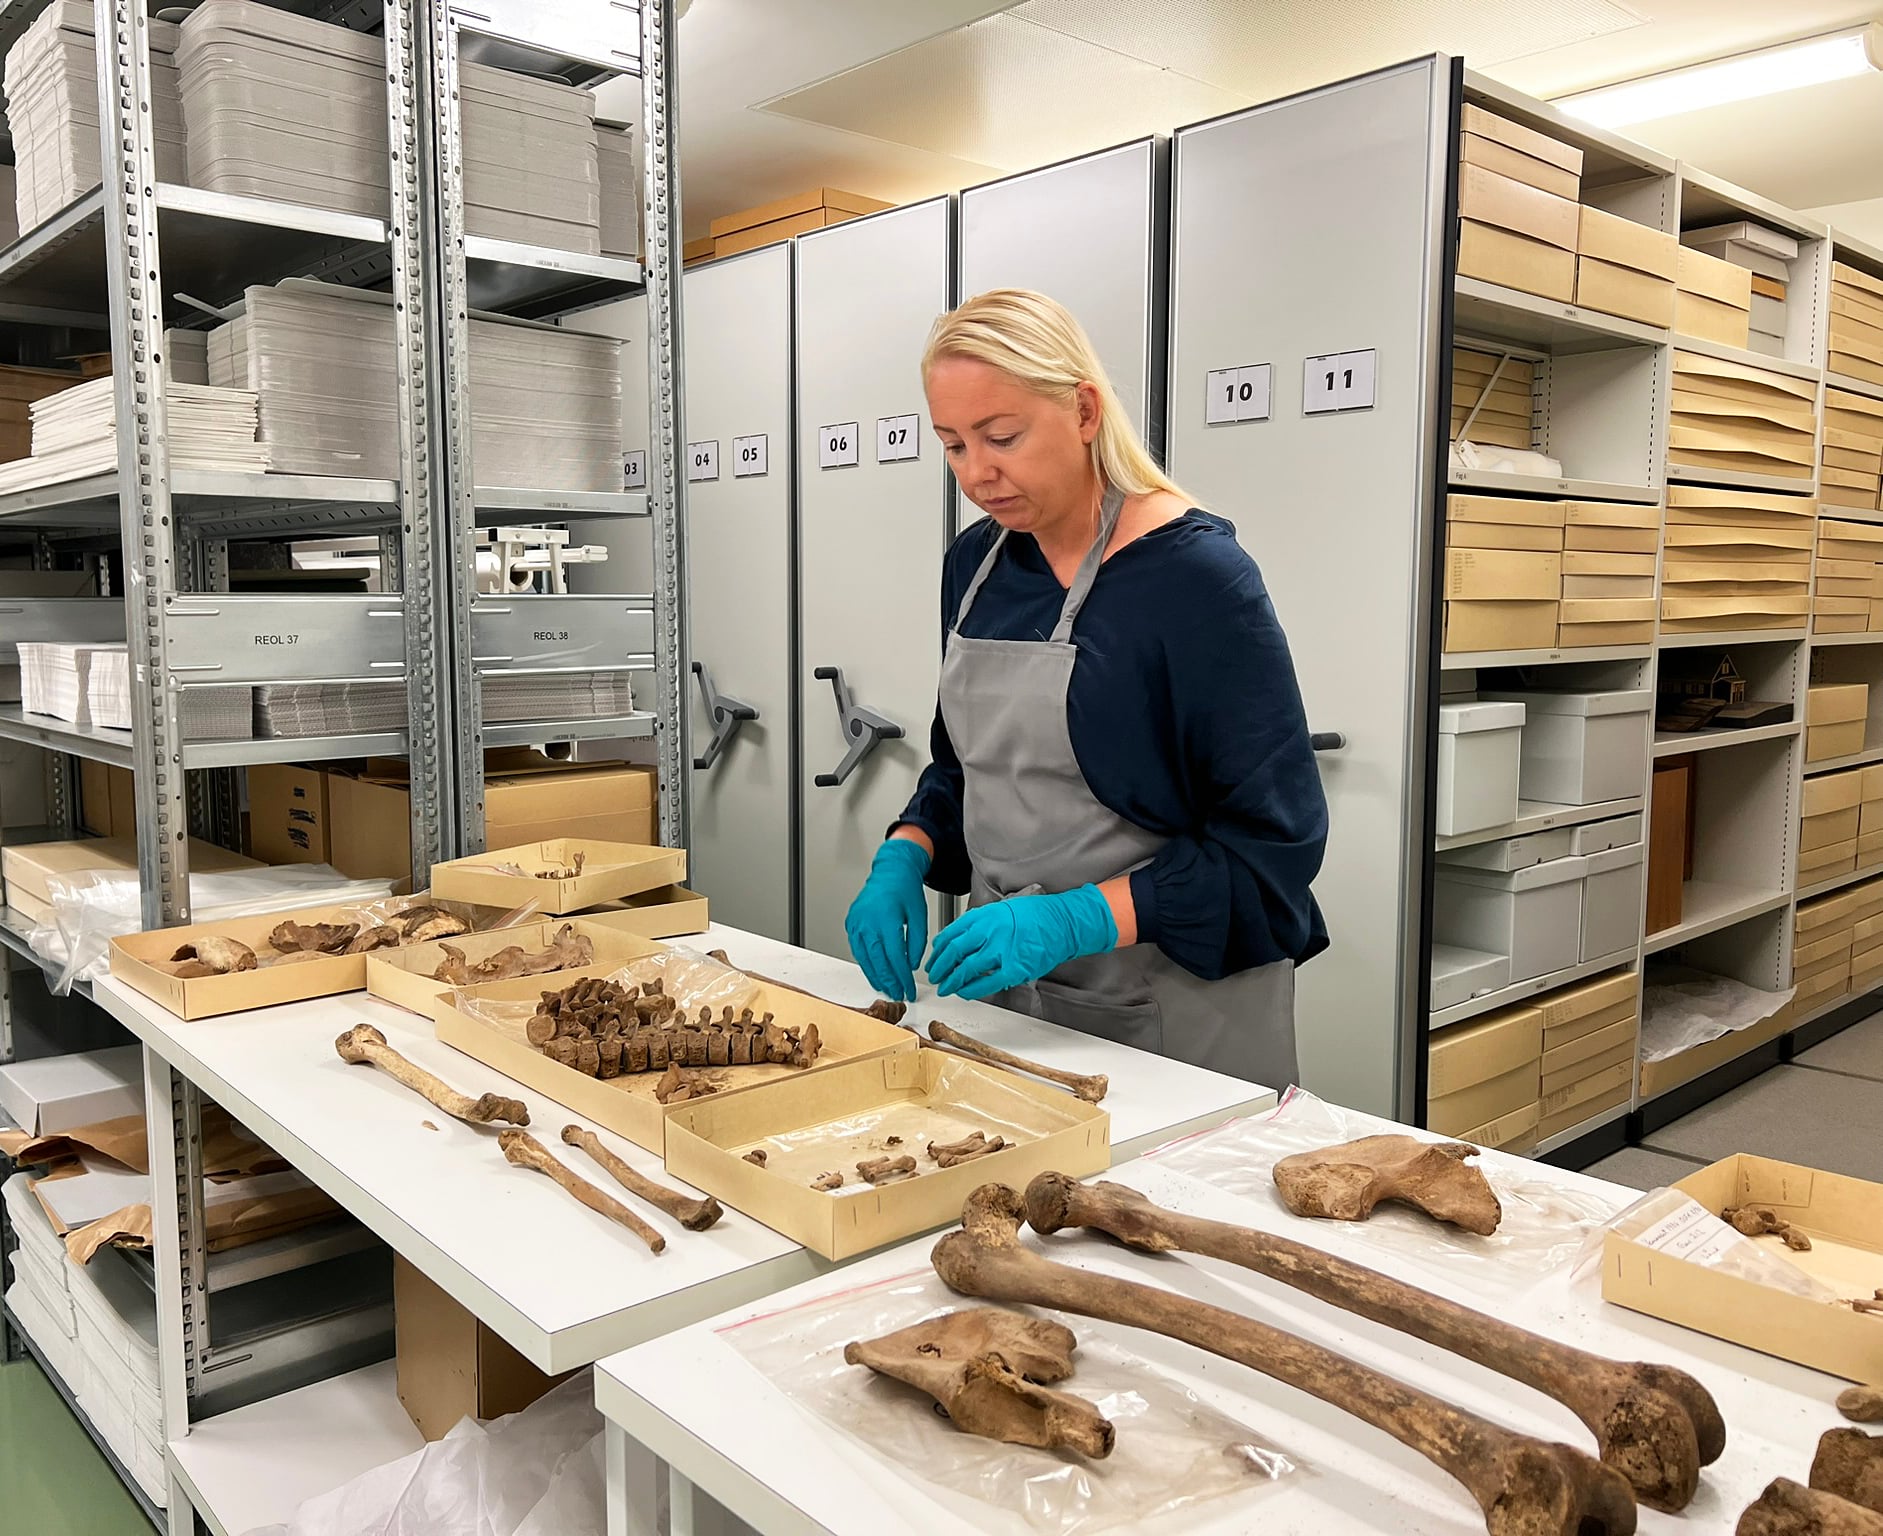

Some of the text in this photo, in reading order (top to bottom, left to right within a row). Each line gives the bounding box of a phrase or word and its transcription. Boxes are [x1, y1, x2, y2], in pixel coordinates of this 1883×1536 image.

[1325, 369, 1353, 391] 11
[1225, 382, 1253, 403] 10
[829, 436, 847, 452] 06
[888, 429, 907, 445] 07
[695, 453, 710, 467] 04
[742, 447, 758, 462] 05
[624, 462, 638, 475] 03
[254, 634, 299, 645] REOL 37
[533, 631, 569, 641] REOL 38
